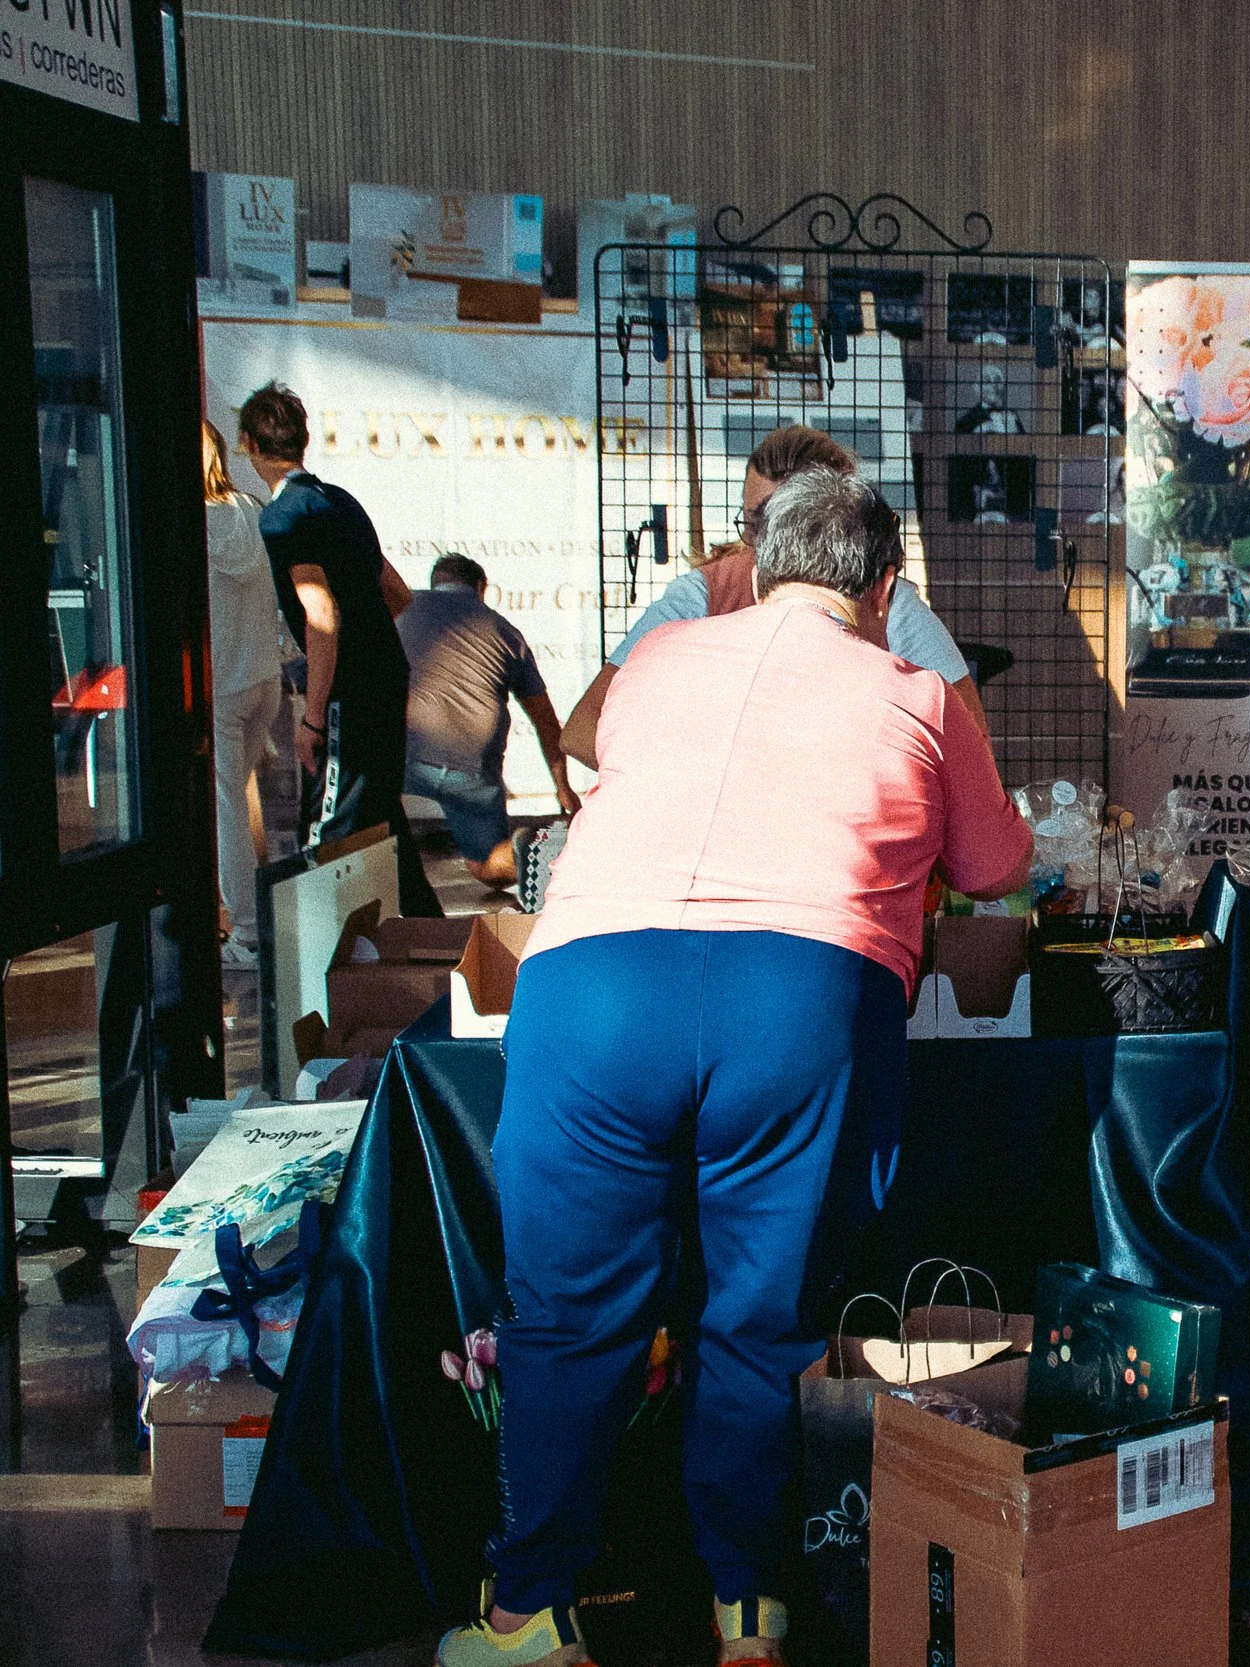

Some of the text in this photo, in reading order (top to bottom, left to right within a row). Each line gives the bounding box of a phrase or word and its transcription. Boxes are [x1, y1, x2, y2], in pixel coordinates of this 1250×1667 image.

[30, 41, 125, 97] correderas
[240, 203, 286, 223] LUX
[319, 408, 649, 464] LUX HOME
[1172, 769, 1223, 792] MÁS
[243, 1128, 323, 1149] ambiente
[930, 1572, 944, 1603] 89
